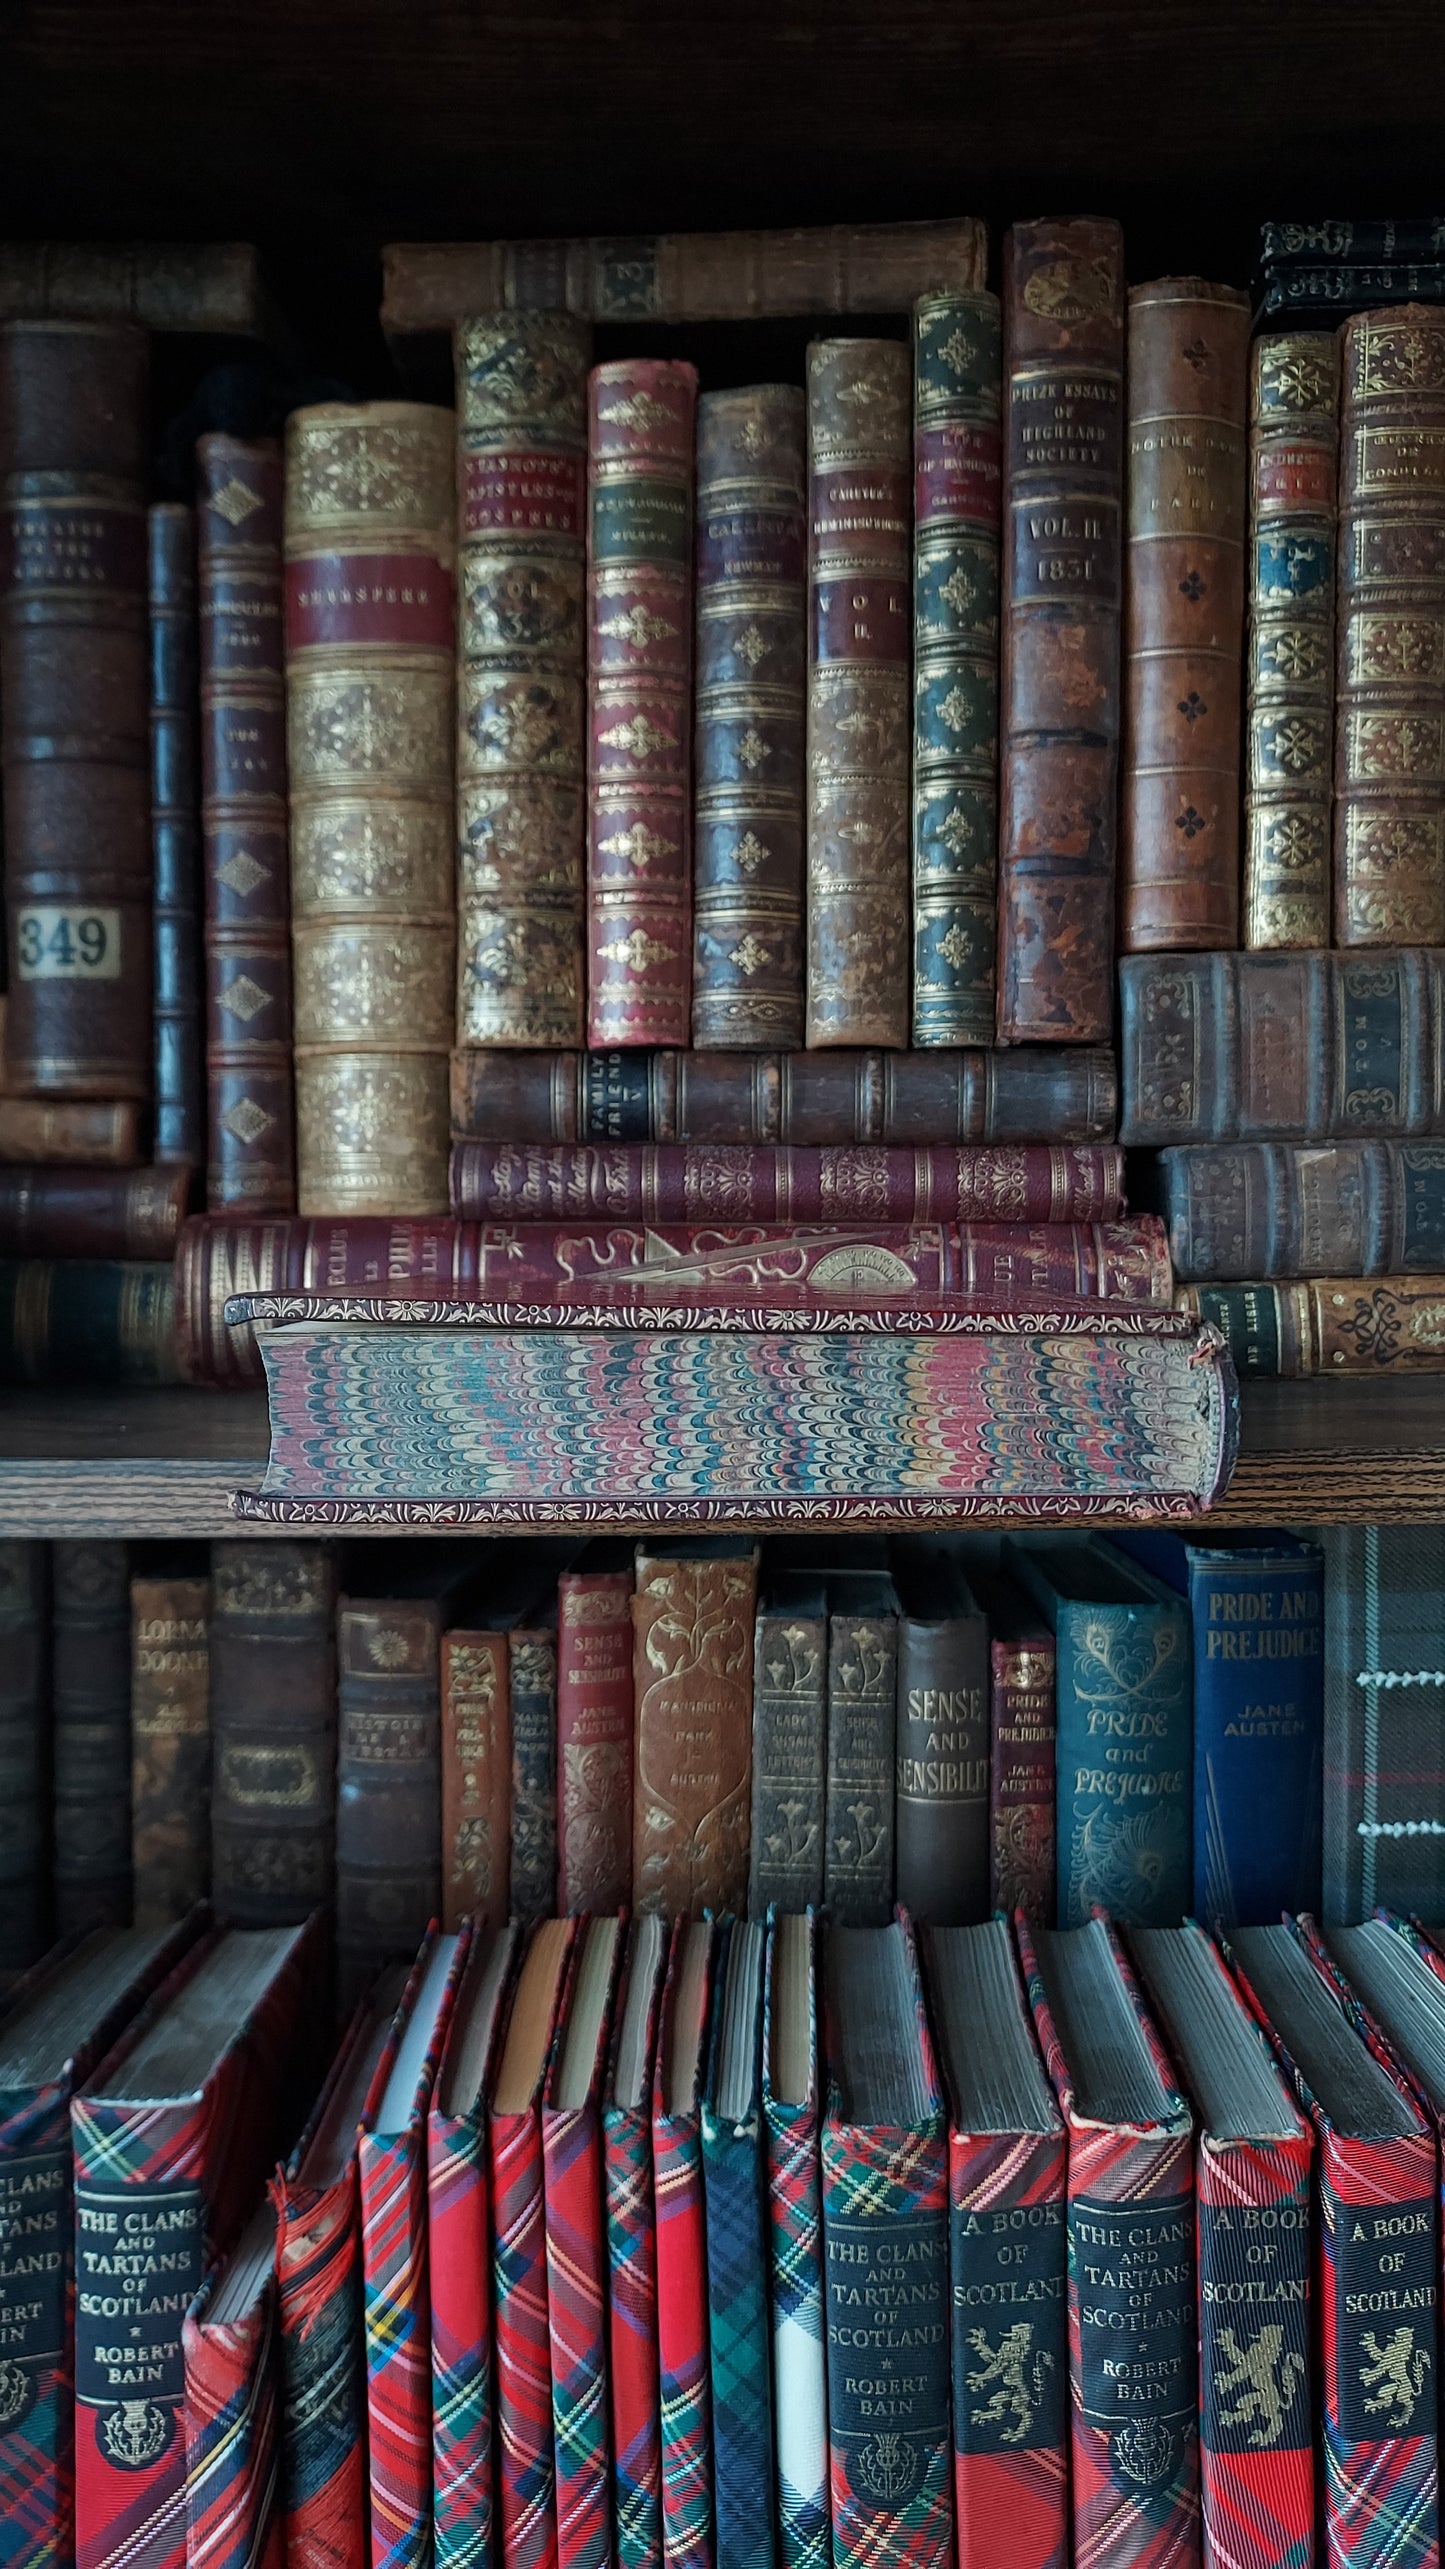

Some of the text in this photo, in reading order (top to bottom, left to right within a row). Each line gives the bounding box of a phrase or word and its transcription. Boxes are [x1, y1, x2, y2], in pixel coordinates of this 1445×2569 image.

[1012, 383, 1116, 403] PRIZE ESSAYS
[1054, 404, 1075, 420] OF
[1022, 425, 1106, 444] HIGHLAND
[1025, 448, 1100, 464] SOCIETY
[20, 916, 108, 968] 349
[591, 1056, 604, 1130] FAMILY
[607, 1052, 622, 1137] FRIEND
[1208, 1591, 1319, 1622] PRIDE AND
[137, 1617, 207, 1641] LORNA
[573, 1634, 623, 1652] SENSE
[1206, 1627, 1319, 1660] PREJUDICE
[584, 1655, 613, 1667] AND
[907, 1688, 983, 1724] SENSE
[1007, 1693, 1048, 1709] PRIDE
[1237, 1703, 1297, 1720] JANE
[578, 1705, 618, 1721] JANE
[1014, 1711, 1041, 1726] AND
[1085, 1708, 1169, 1737] PRIDE
[1223, 1719, 1305, 1738] AUSTEN
[925, 1731, 970, 1752] AND
[1105, 1743, 1151, 1764] and
[897, 1757, 988, 1795] SENSIBILIT
[1008, 1764, 1046, 1778] JANE
[1073, 1766, 1186, 1805] PREJUDICE
[77, 2207, 198, 2234] THE CLANS
[961, 2206, 1063, 2236] A BOOK
[1213, 2208, 1310, 2231] A BOOK
[1350, 2212, 1432, 2242] A BOOK
[114, 2235, 157, 2252] AND
[1075, 2219, 1193, 2248] THE CLANS
[82, 2250, 193, 2276] TARTANS
[828, 2240, 869, 2265] THE
[997, 2243, 1029, 2265] OF
[1119, 2250, 1159, 2266] AND
[1246, 2244, 1278, 2264] OF
[1378, 2251, 1406, 2274] OF
[122, 2277, 149, 2294] OF
[865, 2267, 907, 2283] AND
[1084, 2262, 1190, 2290] TARTANS
[831, 2282, 941, 2306] TARTANS
[1128, 2292, 1153, 2308] OF
[1345, 2286, 1437, 2314] SCOTLAND
[873, 2310, 899, 2325] OF
[1082, 2304, 1193, 2331] SCOTLAND
[829, 2323, 945, 2348] SCOTLAND
[94, 2342, 180, 2364] ROBERT
[106, 2364, 164, 2385] BAIN
[1102, 2357, 1182, 2379] ROBERT
[845, 2376, 928, 2395] ROBERT
[1117, 2381, 1169, 2400] BAIN
[860, 2399, 914, 2416] BAIN
